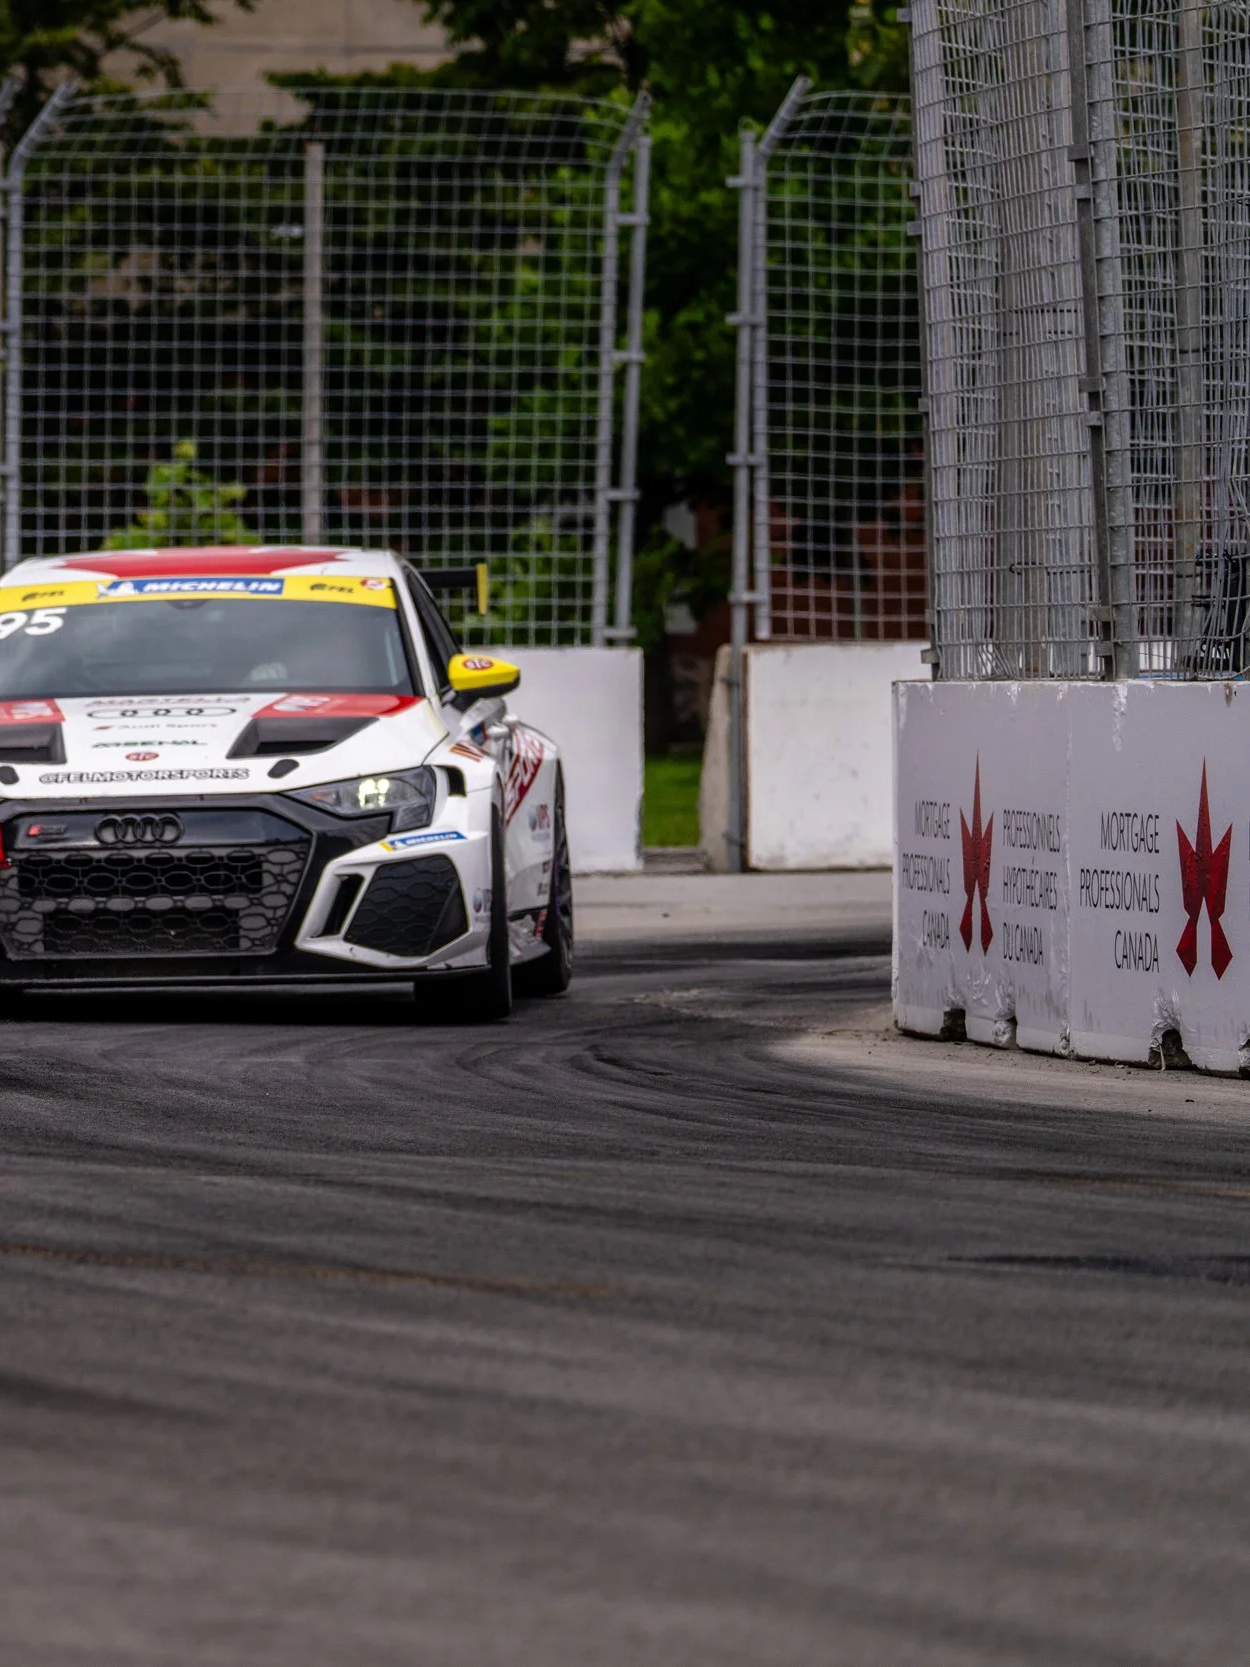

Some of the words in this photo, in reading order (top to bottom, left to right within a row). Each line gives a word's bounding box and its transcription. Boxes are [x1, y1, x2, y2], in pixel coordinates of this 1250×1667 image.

[142, 579, 282, 593] MICHELIN
[39, 768, 250, 784] @FELMOTORSPORTS
[914, 800, 950, 839] MORTGAGE
[1003, 809, 1060, 853] PROFESSIONNELS
[1101, 812, 1160, 854] MORTGAGE
[902, 853, 950, 894] PROFESSIONALS
[1080, 868, 1160, 914] PROFESSIONALS
[923, 910, 949, 949] CANADA
[1003, 922, 1014, 961] DU
[1015, 924, 1044, 966] CANADA
[1114, 930, 1160, 973] CANADA
